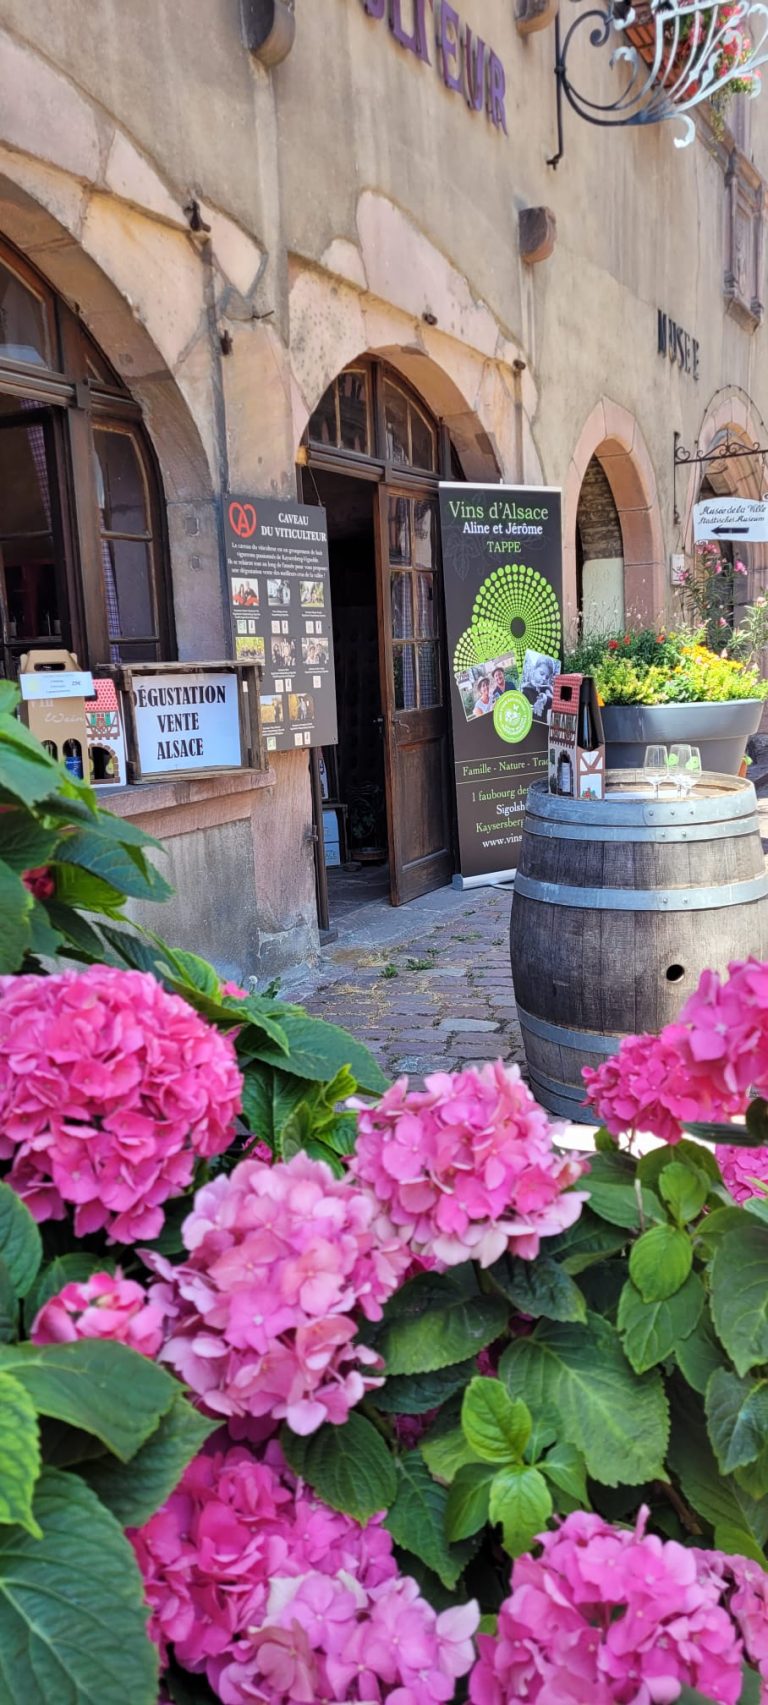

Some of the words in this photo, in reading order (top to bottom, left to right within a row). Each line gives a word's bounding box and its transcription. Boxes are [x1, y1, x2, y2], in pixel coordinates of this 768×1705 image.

[449, 501, 484, 518] Vins
[489, 502, 548, 520] d'Alsace
[278, 513, 309, 525] CAVEAU
[261, 526, 273, 536] DU
[275, 527, 327, 542] VITICULTEUR
[463, 522, 490, 534] Aline
[493, 523, 503, 534] et
[505, 522, 543, 535] Jérôme
[487, 541, 521, 553] TAPPE
[157, 712, 199, 733] VENTE
[157, 738, 204, 760] ALSACE
[463, 763, 491, 776] Famille
[499, 761, 526, 772] Nature
[479, 788, 515, 801] faubourg
